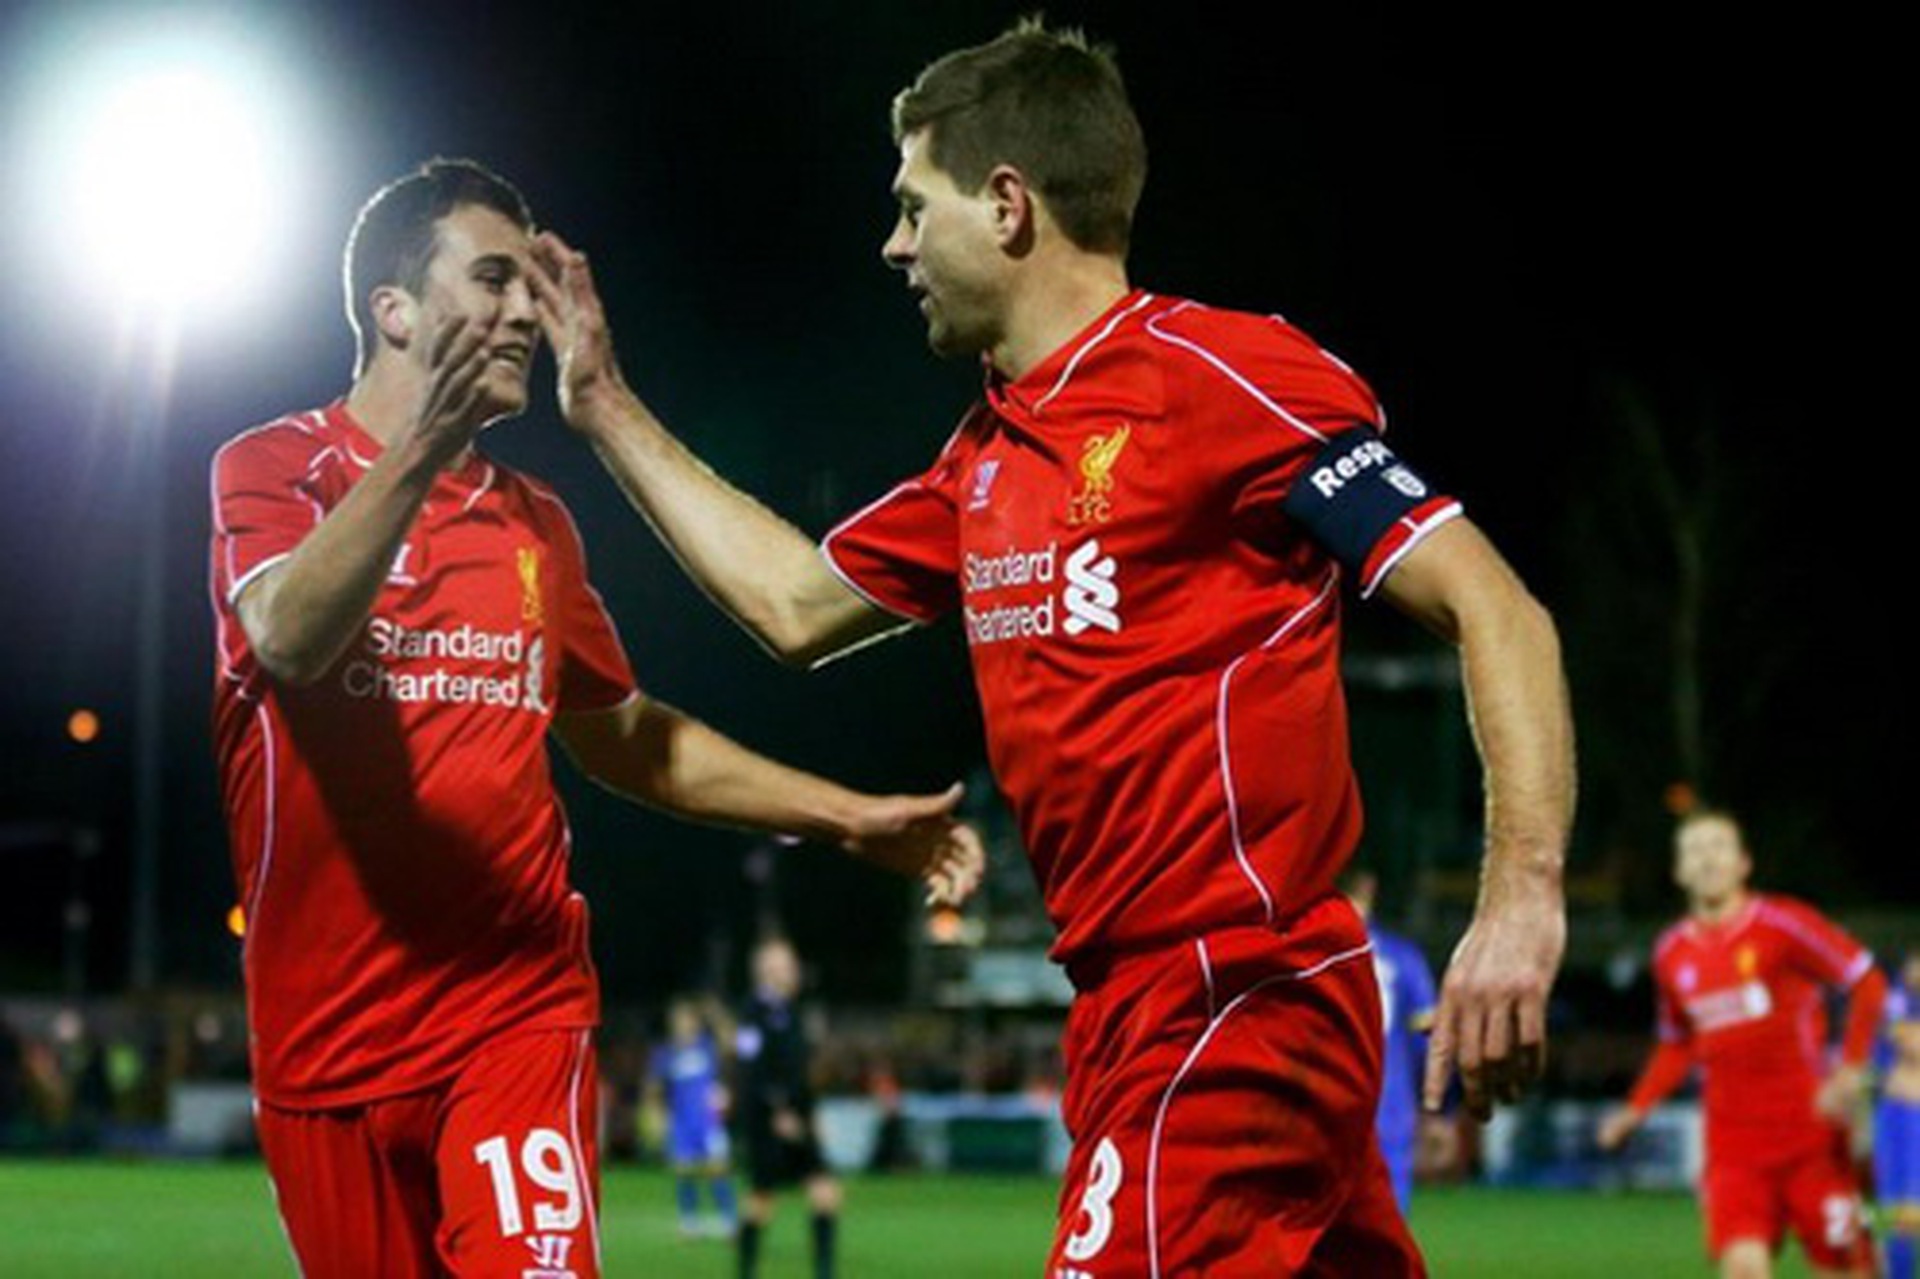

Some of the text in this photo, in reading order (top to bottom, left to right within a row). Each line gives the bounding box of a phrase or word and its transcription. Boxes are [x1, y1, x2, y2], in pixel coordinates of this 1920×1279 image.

[1310, 440, 1394, 498] Resp
[369, 617, 523, 663] Standard
[343, 661, 521, 707] Chartered
[473, 1128, 583, 1237] 19
